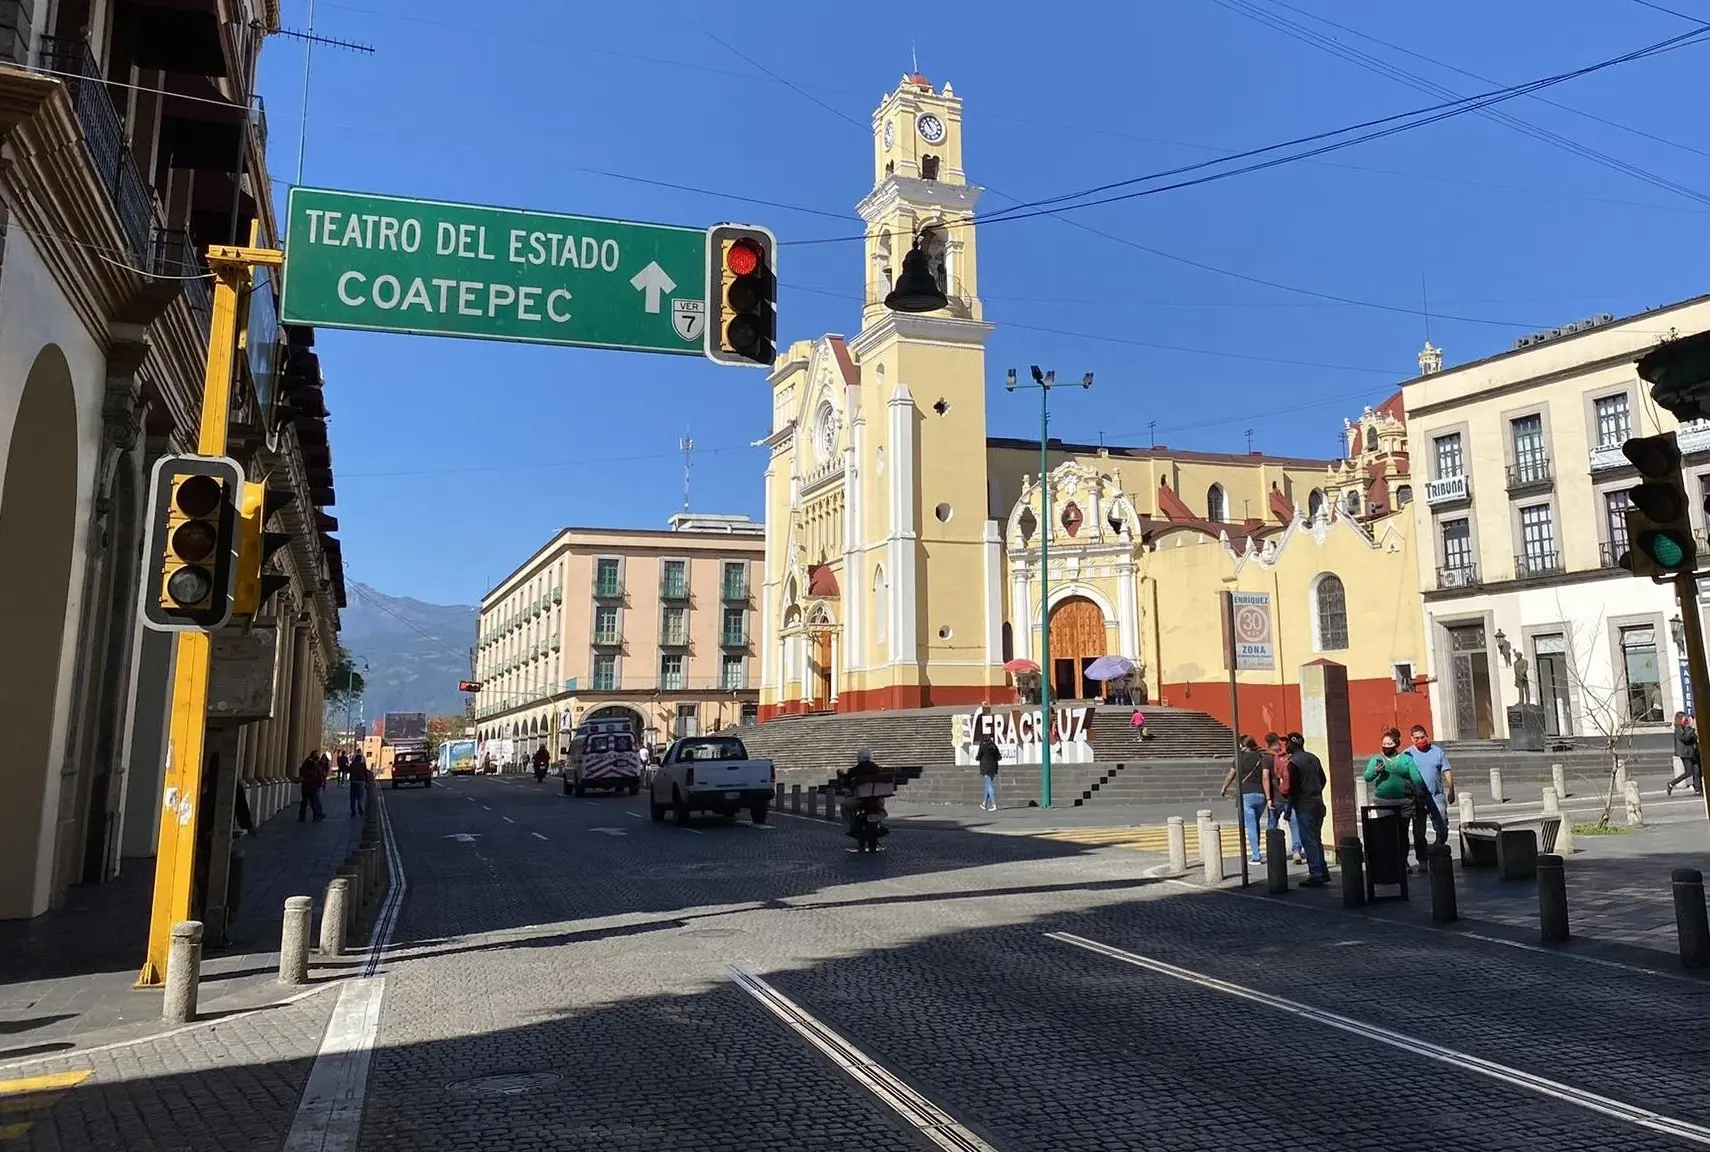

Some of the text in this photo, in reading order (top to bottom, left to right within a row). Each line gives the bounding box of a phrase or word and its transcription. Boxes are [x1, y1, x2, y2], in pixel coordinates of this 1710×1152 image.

[305, 209, 619, 272] TEATRO DEL ESTADO
[337, 270, 573, 323] COATEPEC
[680, 302, 699, 310] VER
[682, 315, 696, 333] 7
[1425, 479, 1464, 499] TRIBUNA
[1242, 611, 1262, 631] 30
[1242, 645, 1266, 655] ZONA
[963, 706, 1088, 745] VERACRUZ
